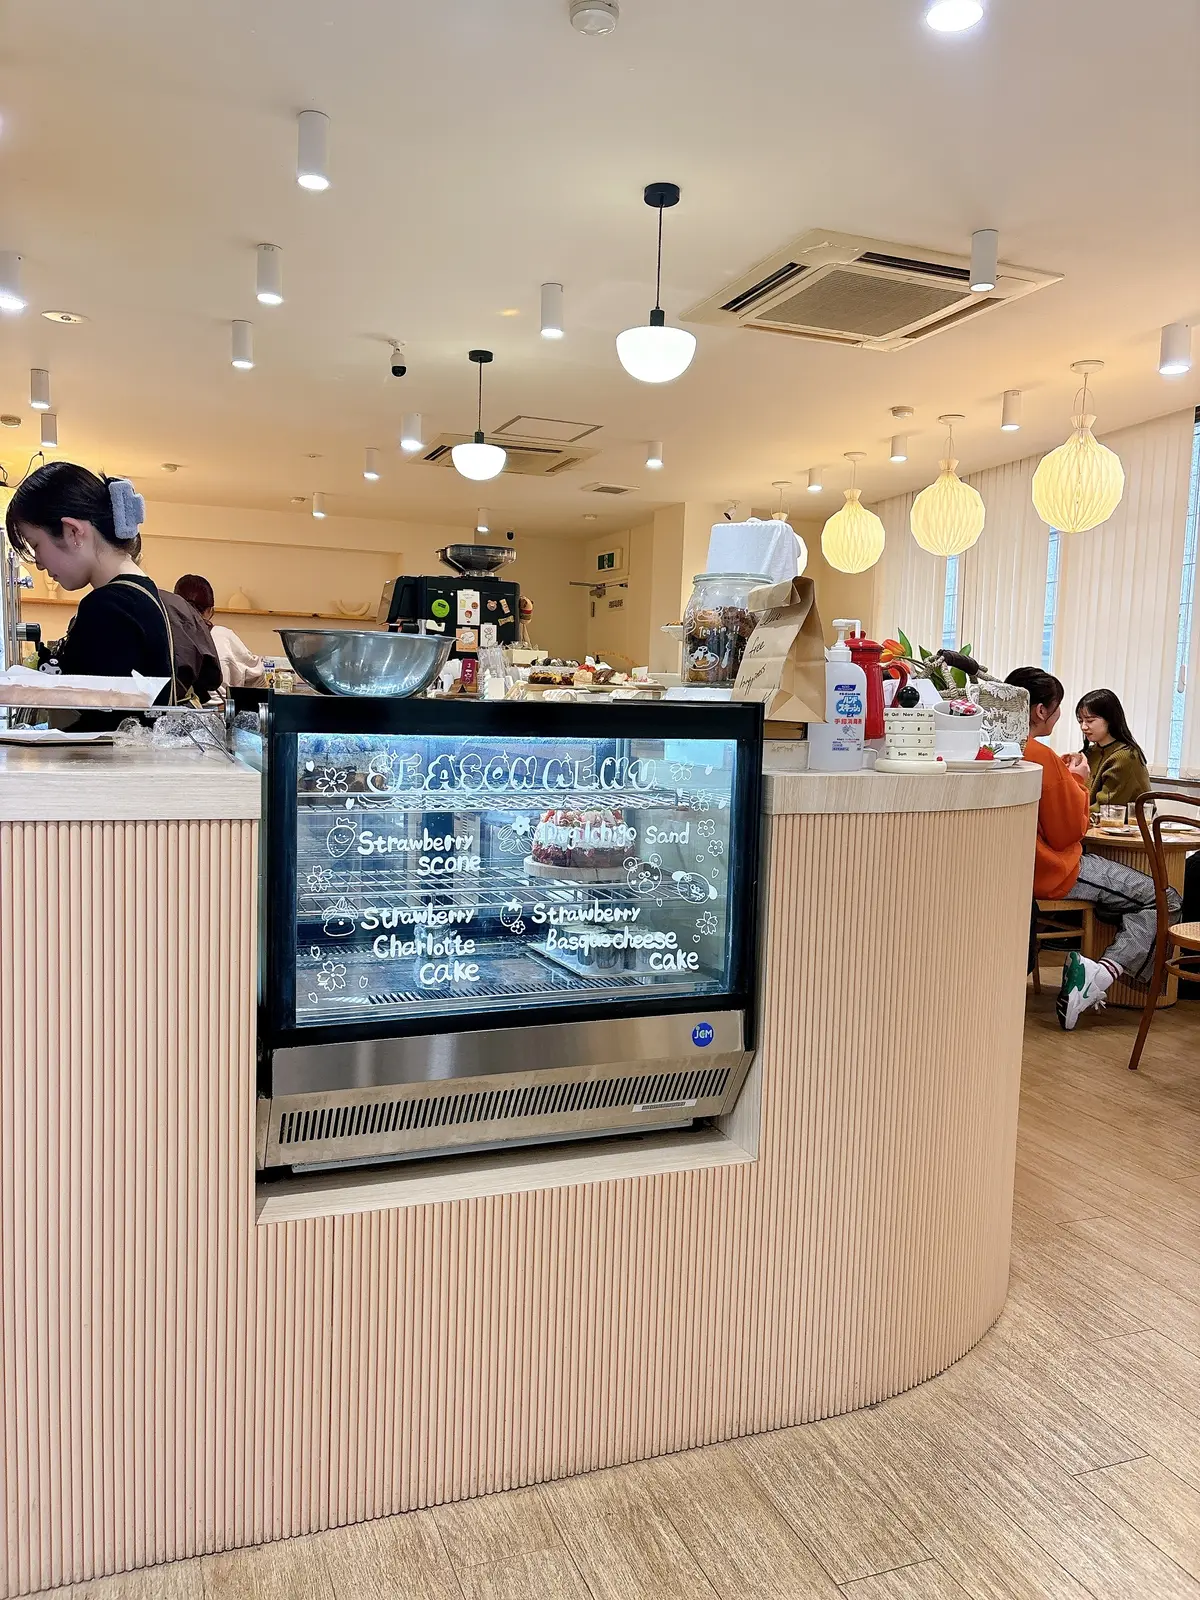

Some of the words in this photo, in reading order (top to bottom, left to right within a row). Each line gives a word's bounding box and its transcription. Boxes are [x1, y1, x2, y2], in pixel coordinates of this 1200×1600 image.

[368, 753, 537, 793] SEASON
[542, 756, 658, 792] MENU
[357, 827, 474, 855] Strawberry
[644, 821, 690, 845] Sand
[416, 855, 482, 876] scone
[360, 902, 475, 930] Strawberry
[531, 897, 641, 924] Strawberry
[373, 933, 477, 959] Charlotte
[419, 960, 481, 985] cake
[649, 948, 700, 971] cake
